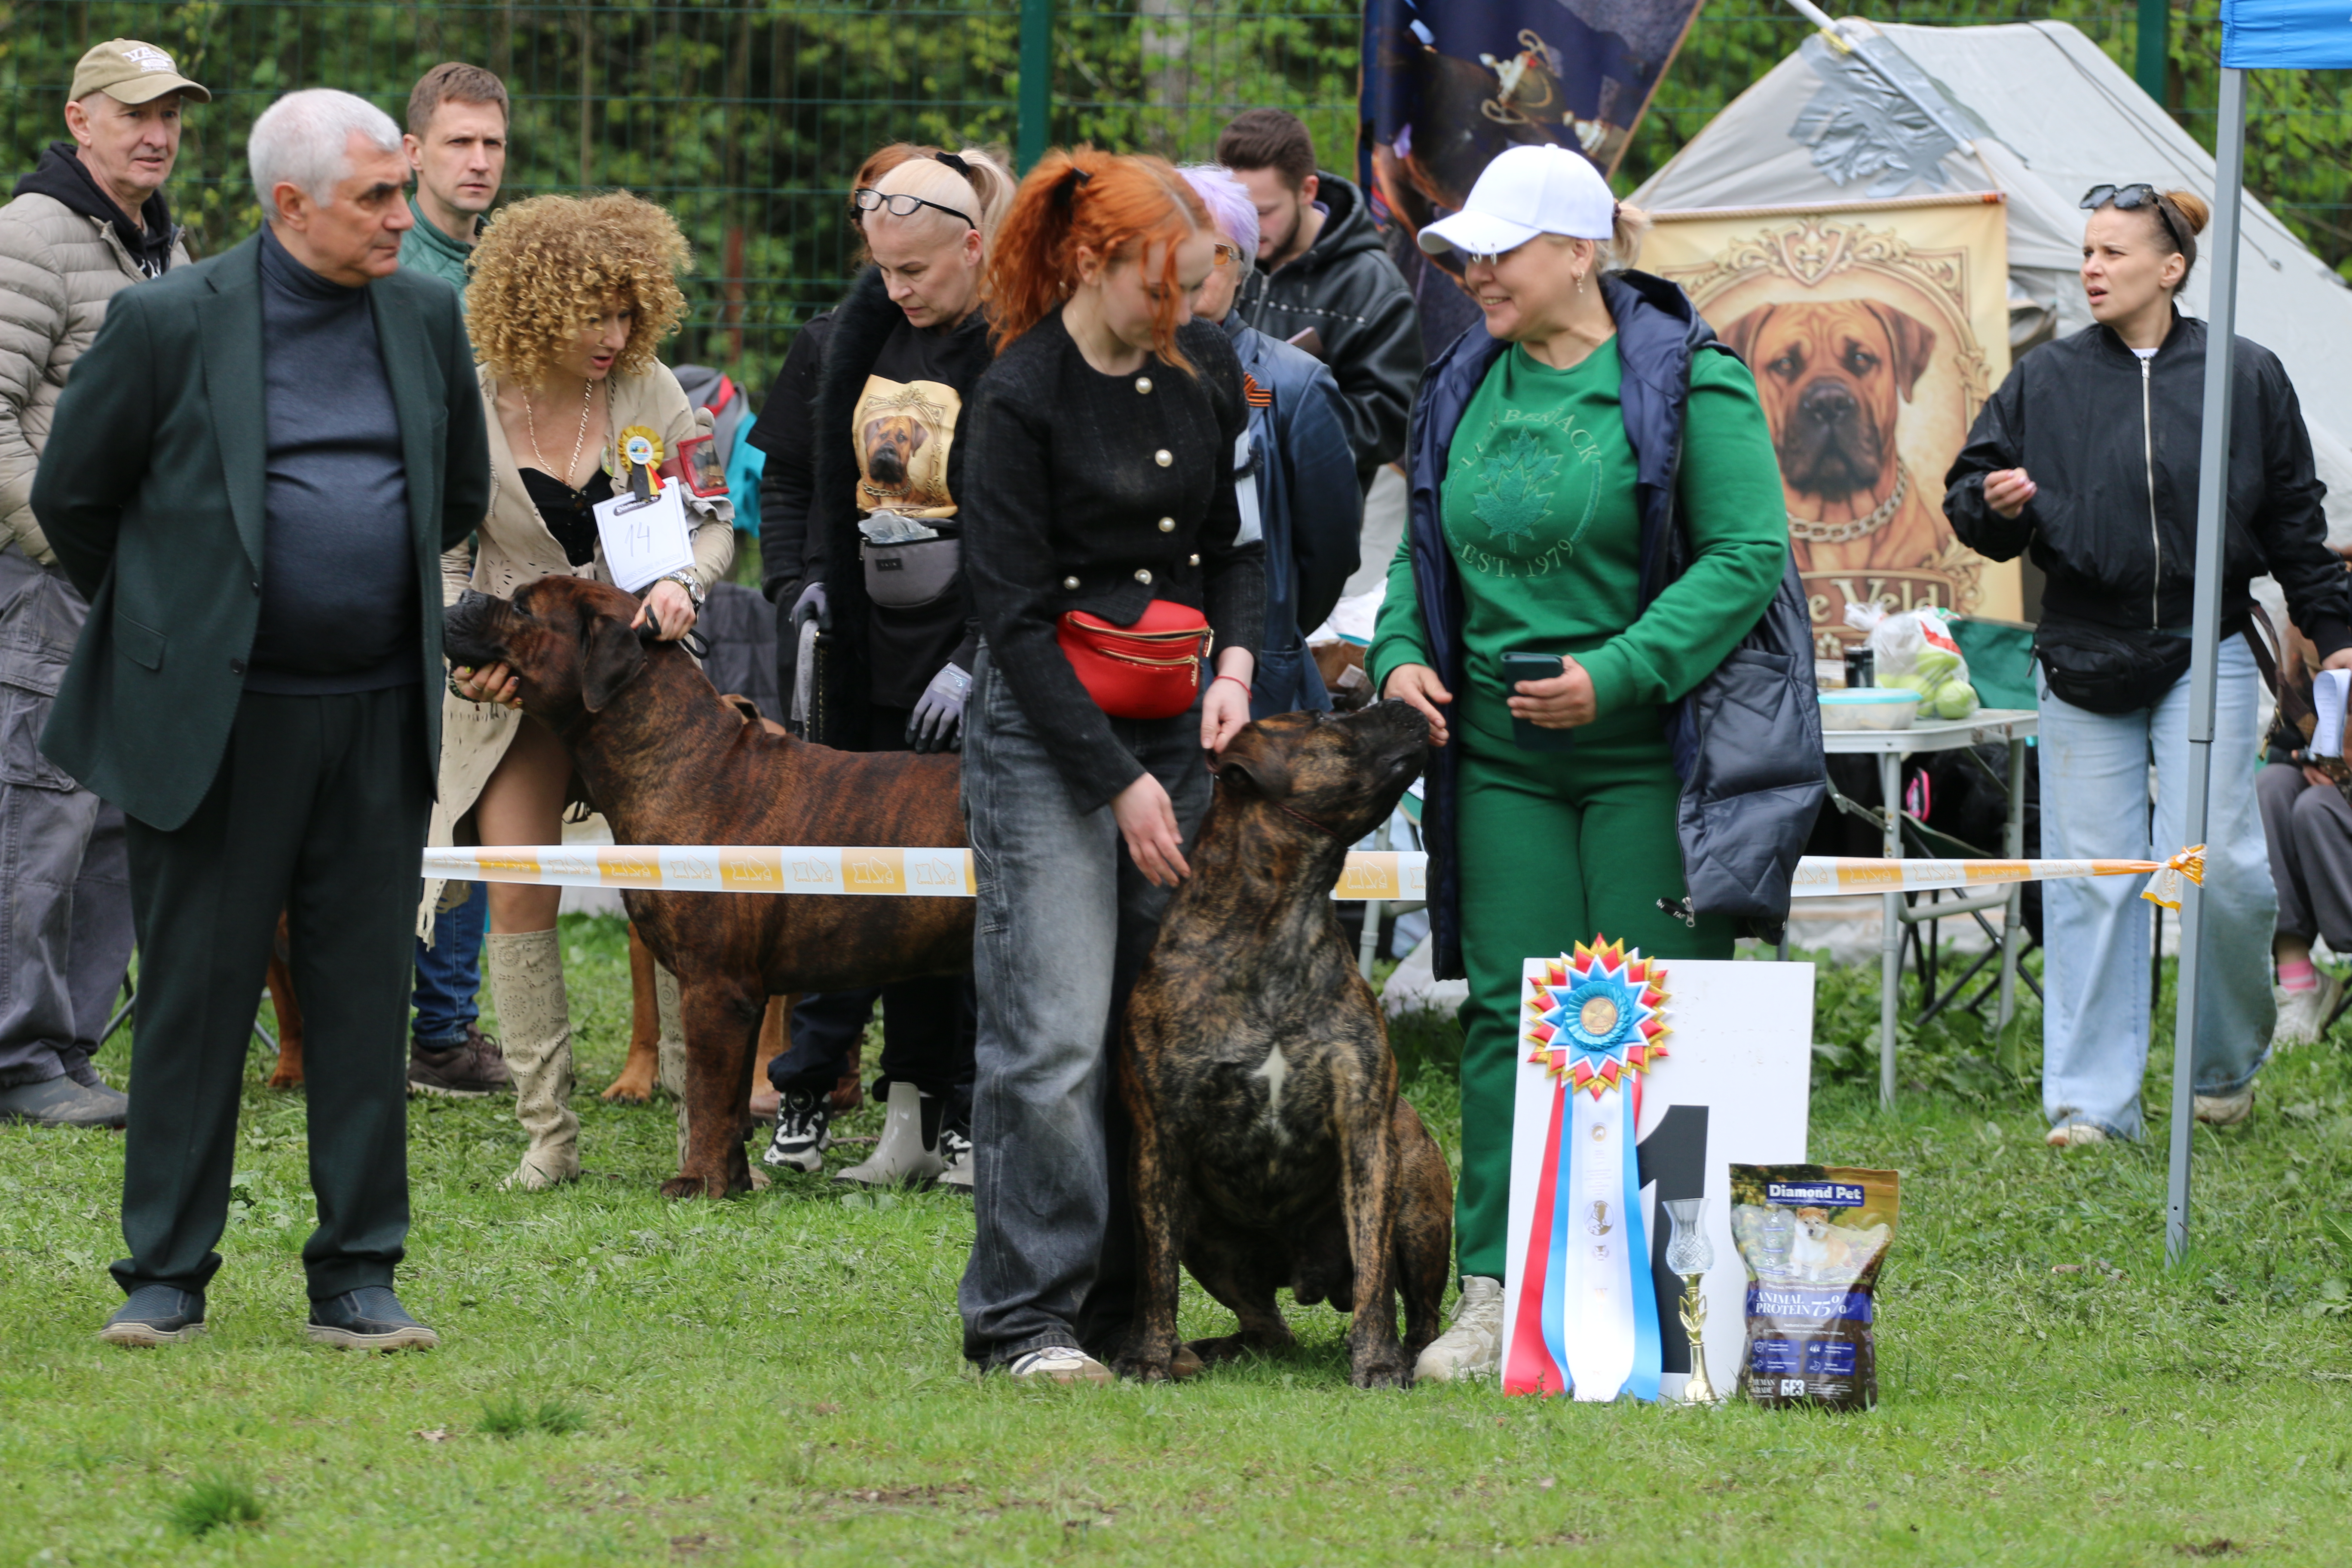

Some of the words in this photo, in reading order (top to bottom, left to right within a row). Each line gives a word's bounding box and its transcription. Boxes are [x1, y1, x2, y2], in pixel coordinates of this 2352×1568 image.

[625, 521, 651, 557] 14
[1460, 541, 1516, 578] EST.
[1527, 539, 1573, 578] 1979
[1830, 578, 1939, 614] Veld
[1769, 1184, 1833, 1198] Diamond
[1836, 1186, 1862, 1200] Pet
[1636, 1105, 1709, 1374] 1
[1755, 1302, 1810, 1315] PROTEIN
[1810, 1295, 1847, 1317] 75%
[1757, 1292, 1804, 1304] ANIMAL
[1780, 1379, 1805, 1396] БЕЗ
